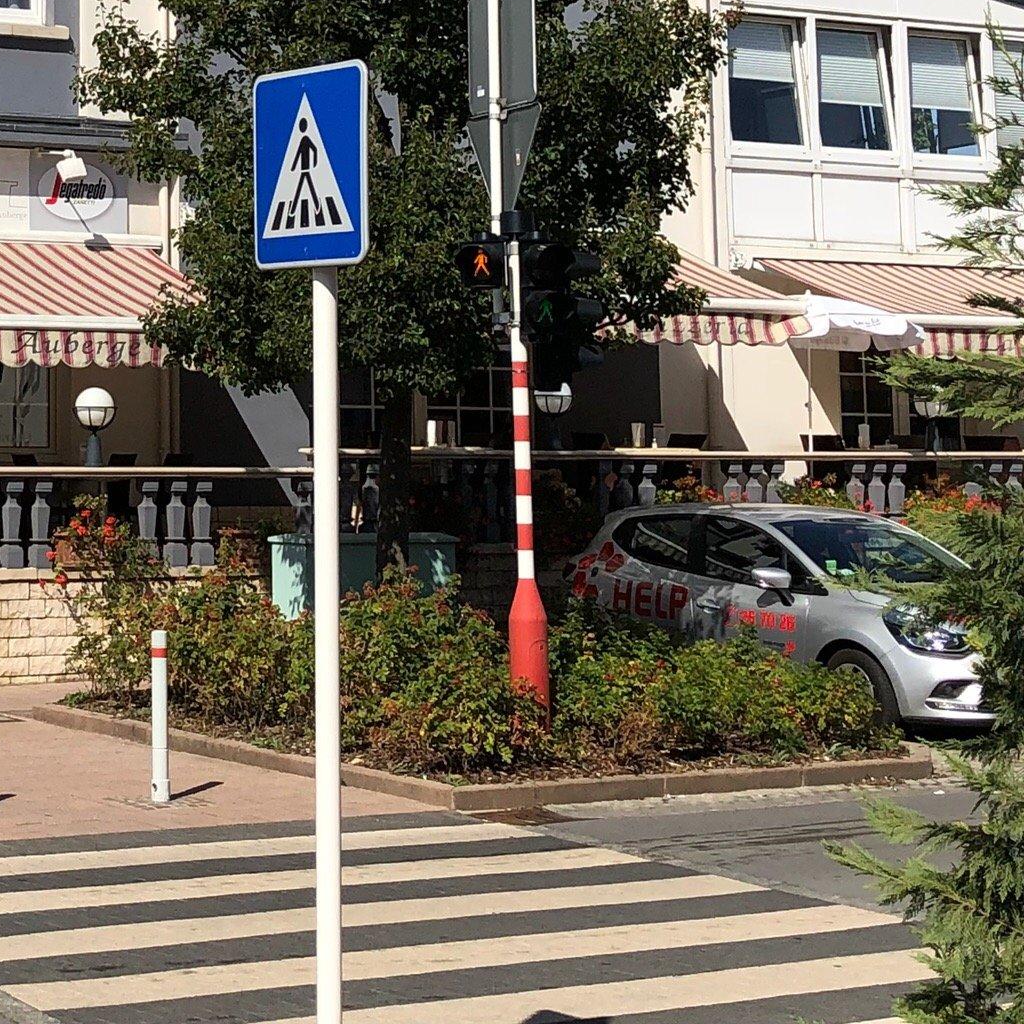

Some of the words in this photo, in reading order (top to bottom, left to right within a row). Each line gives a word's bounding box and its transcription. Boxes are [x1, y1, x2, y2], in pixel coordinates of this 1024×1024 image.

[658, 318, 750, 336] izzeria
[11, 331, 141, 363] Auberge
[611, 578, 689, 619] HELP
